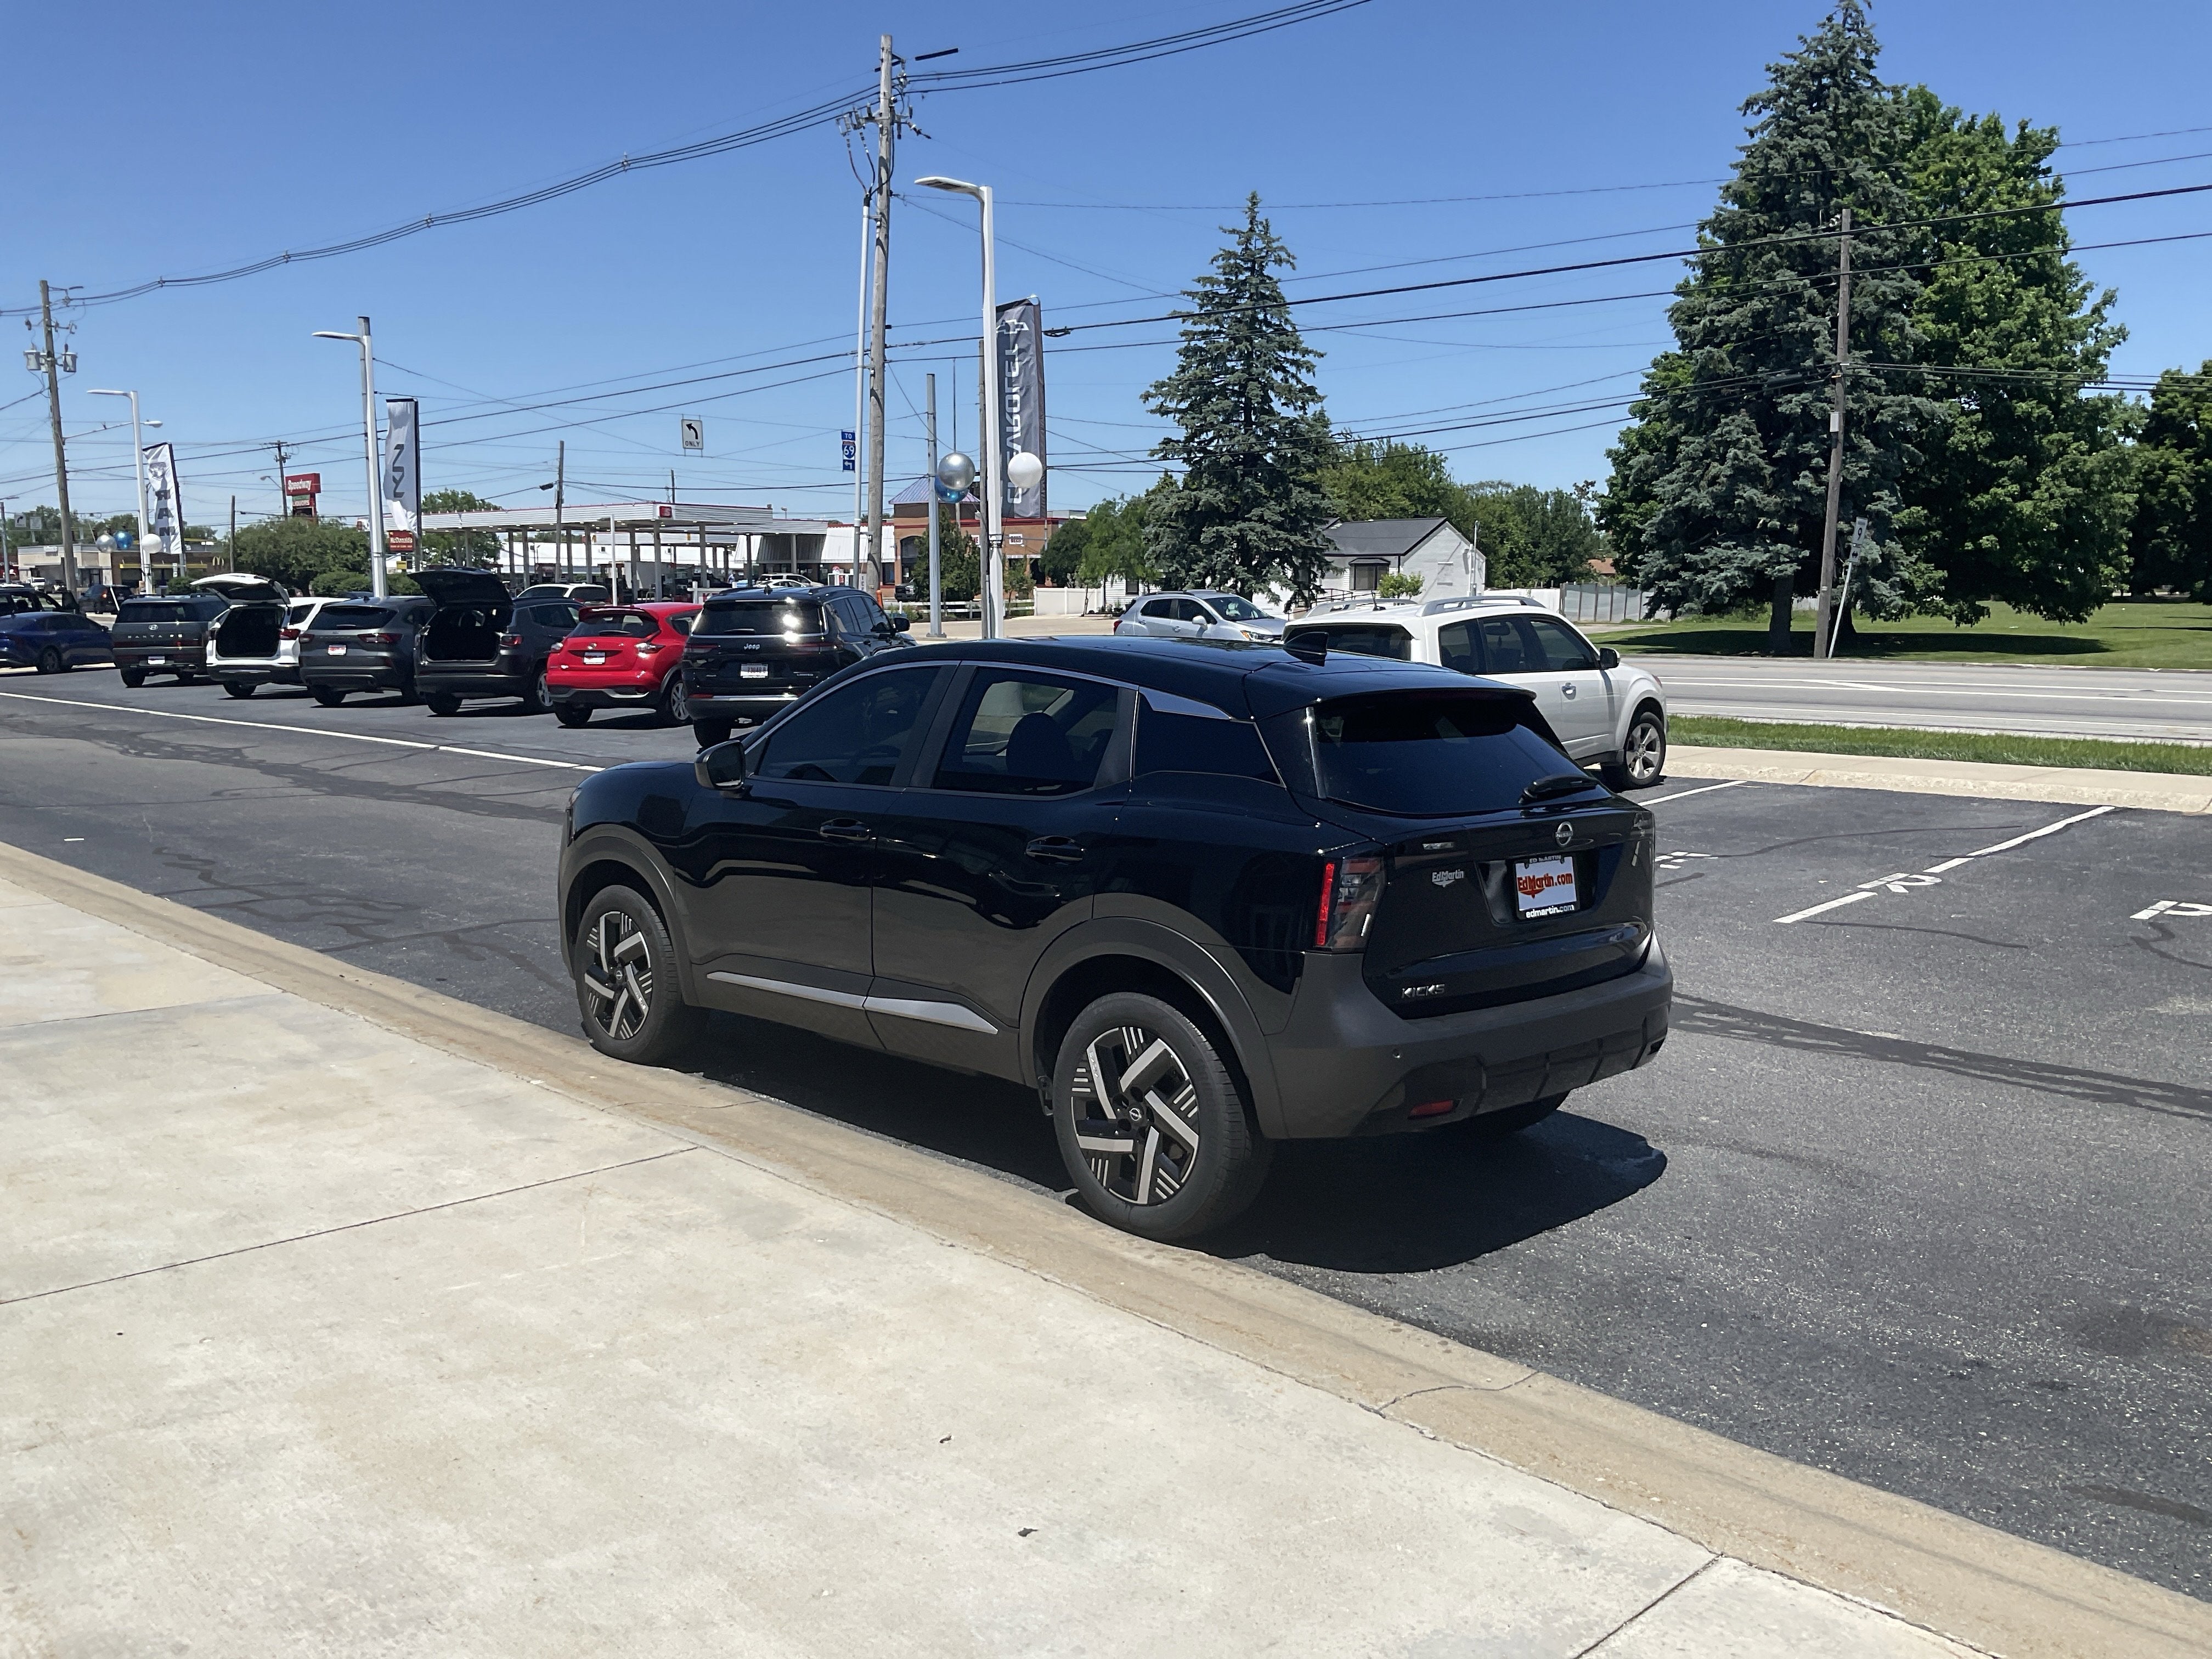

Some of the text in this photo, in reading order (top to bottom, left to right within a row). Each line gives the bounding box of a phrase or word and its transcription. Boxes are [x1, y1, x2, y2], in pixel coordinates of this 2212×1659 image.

[844, 445, 854, 455] 69
[288, 479, 312, 492] Speedway
[1858, 528, 1862, 540] 9
[1432, 869, 1464, 882] EdMartin
[1517, 873, 1573, 891] EdMartin.com
[1526, 905, 1575, 918] edmartin.com
[1401, 984, 1445, 998] KICKS
